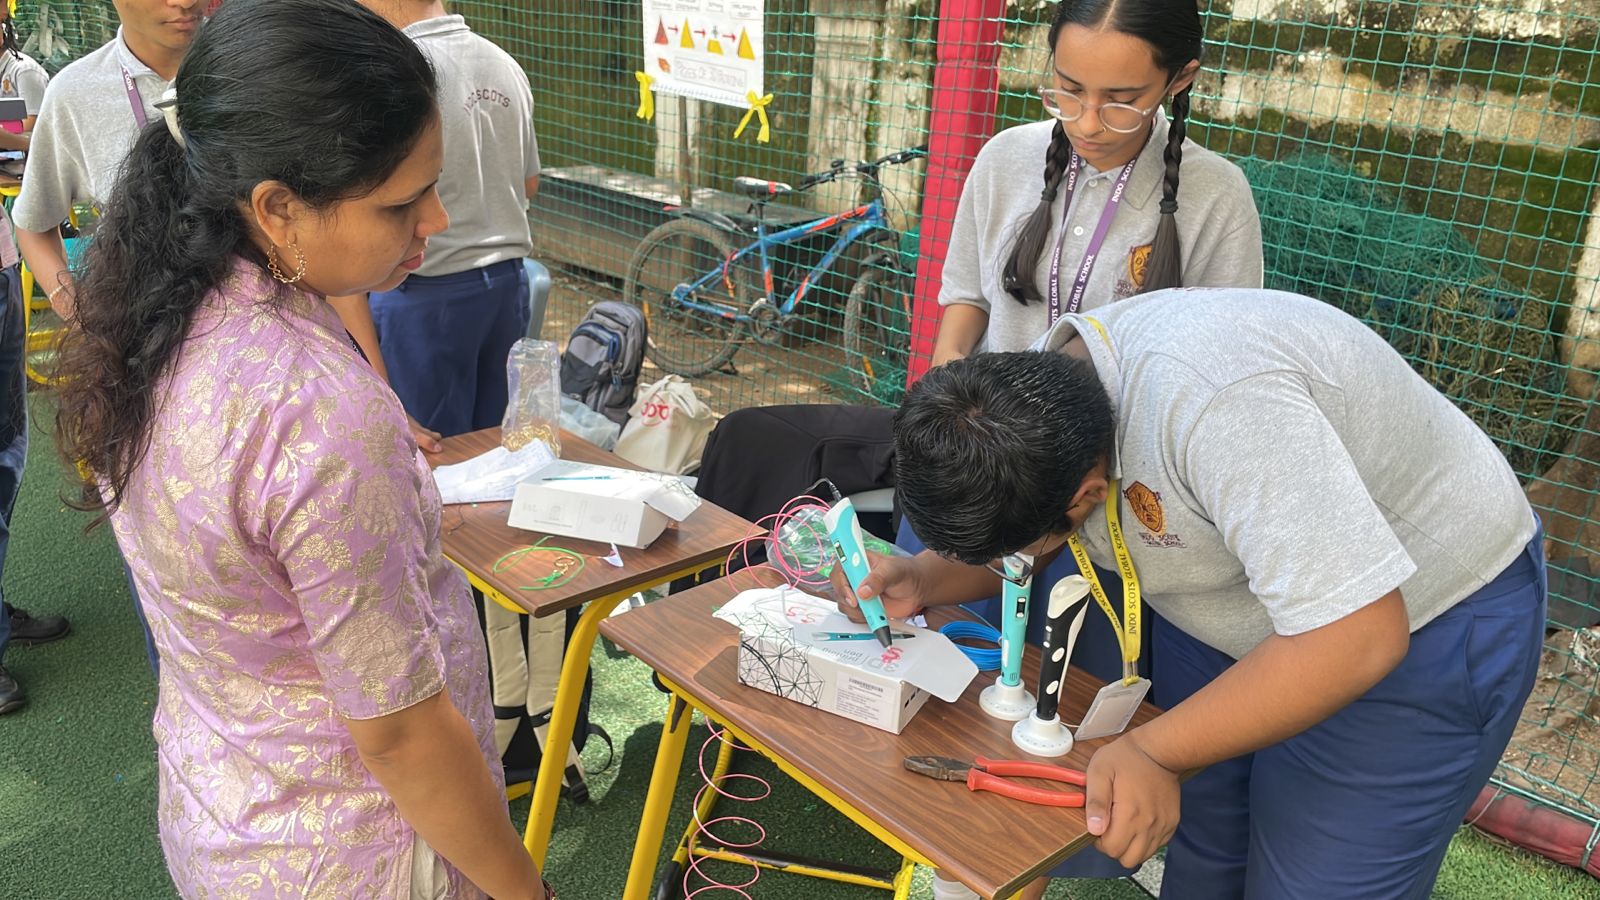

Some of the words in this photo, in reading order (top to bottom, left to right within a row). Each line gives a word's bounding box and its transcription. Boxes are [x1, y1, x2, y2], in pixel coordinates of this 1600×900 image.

[1067, 171, 1076, 191] INDO
[1111, 183, 1124, 203] INDO
[1121, 159, 1136, 182] SCOTS
[1070, 285, 1083, 312] GLOBAL
[1079, 254, 1095, 283] SCHOOL
[1051, 308, 1059, 323] OTS
[1110, 520, 1124, 551] SCHOOL
[1075, 549, 1093, 580] GLOBAL
[1118, 553, 1133, 579] GLOBAL
[1091, 582, 1108, 607] SCOTS
[1128, 582, 1136, 609] SCOTS
[1128, 612, 1137, 635] INDO
